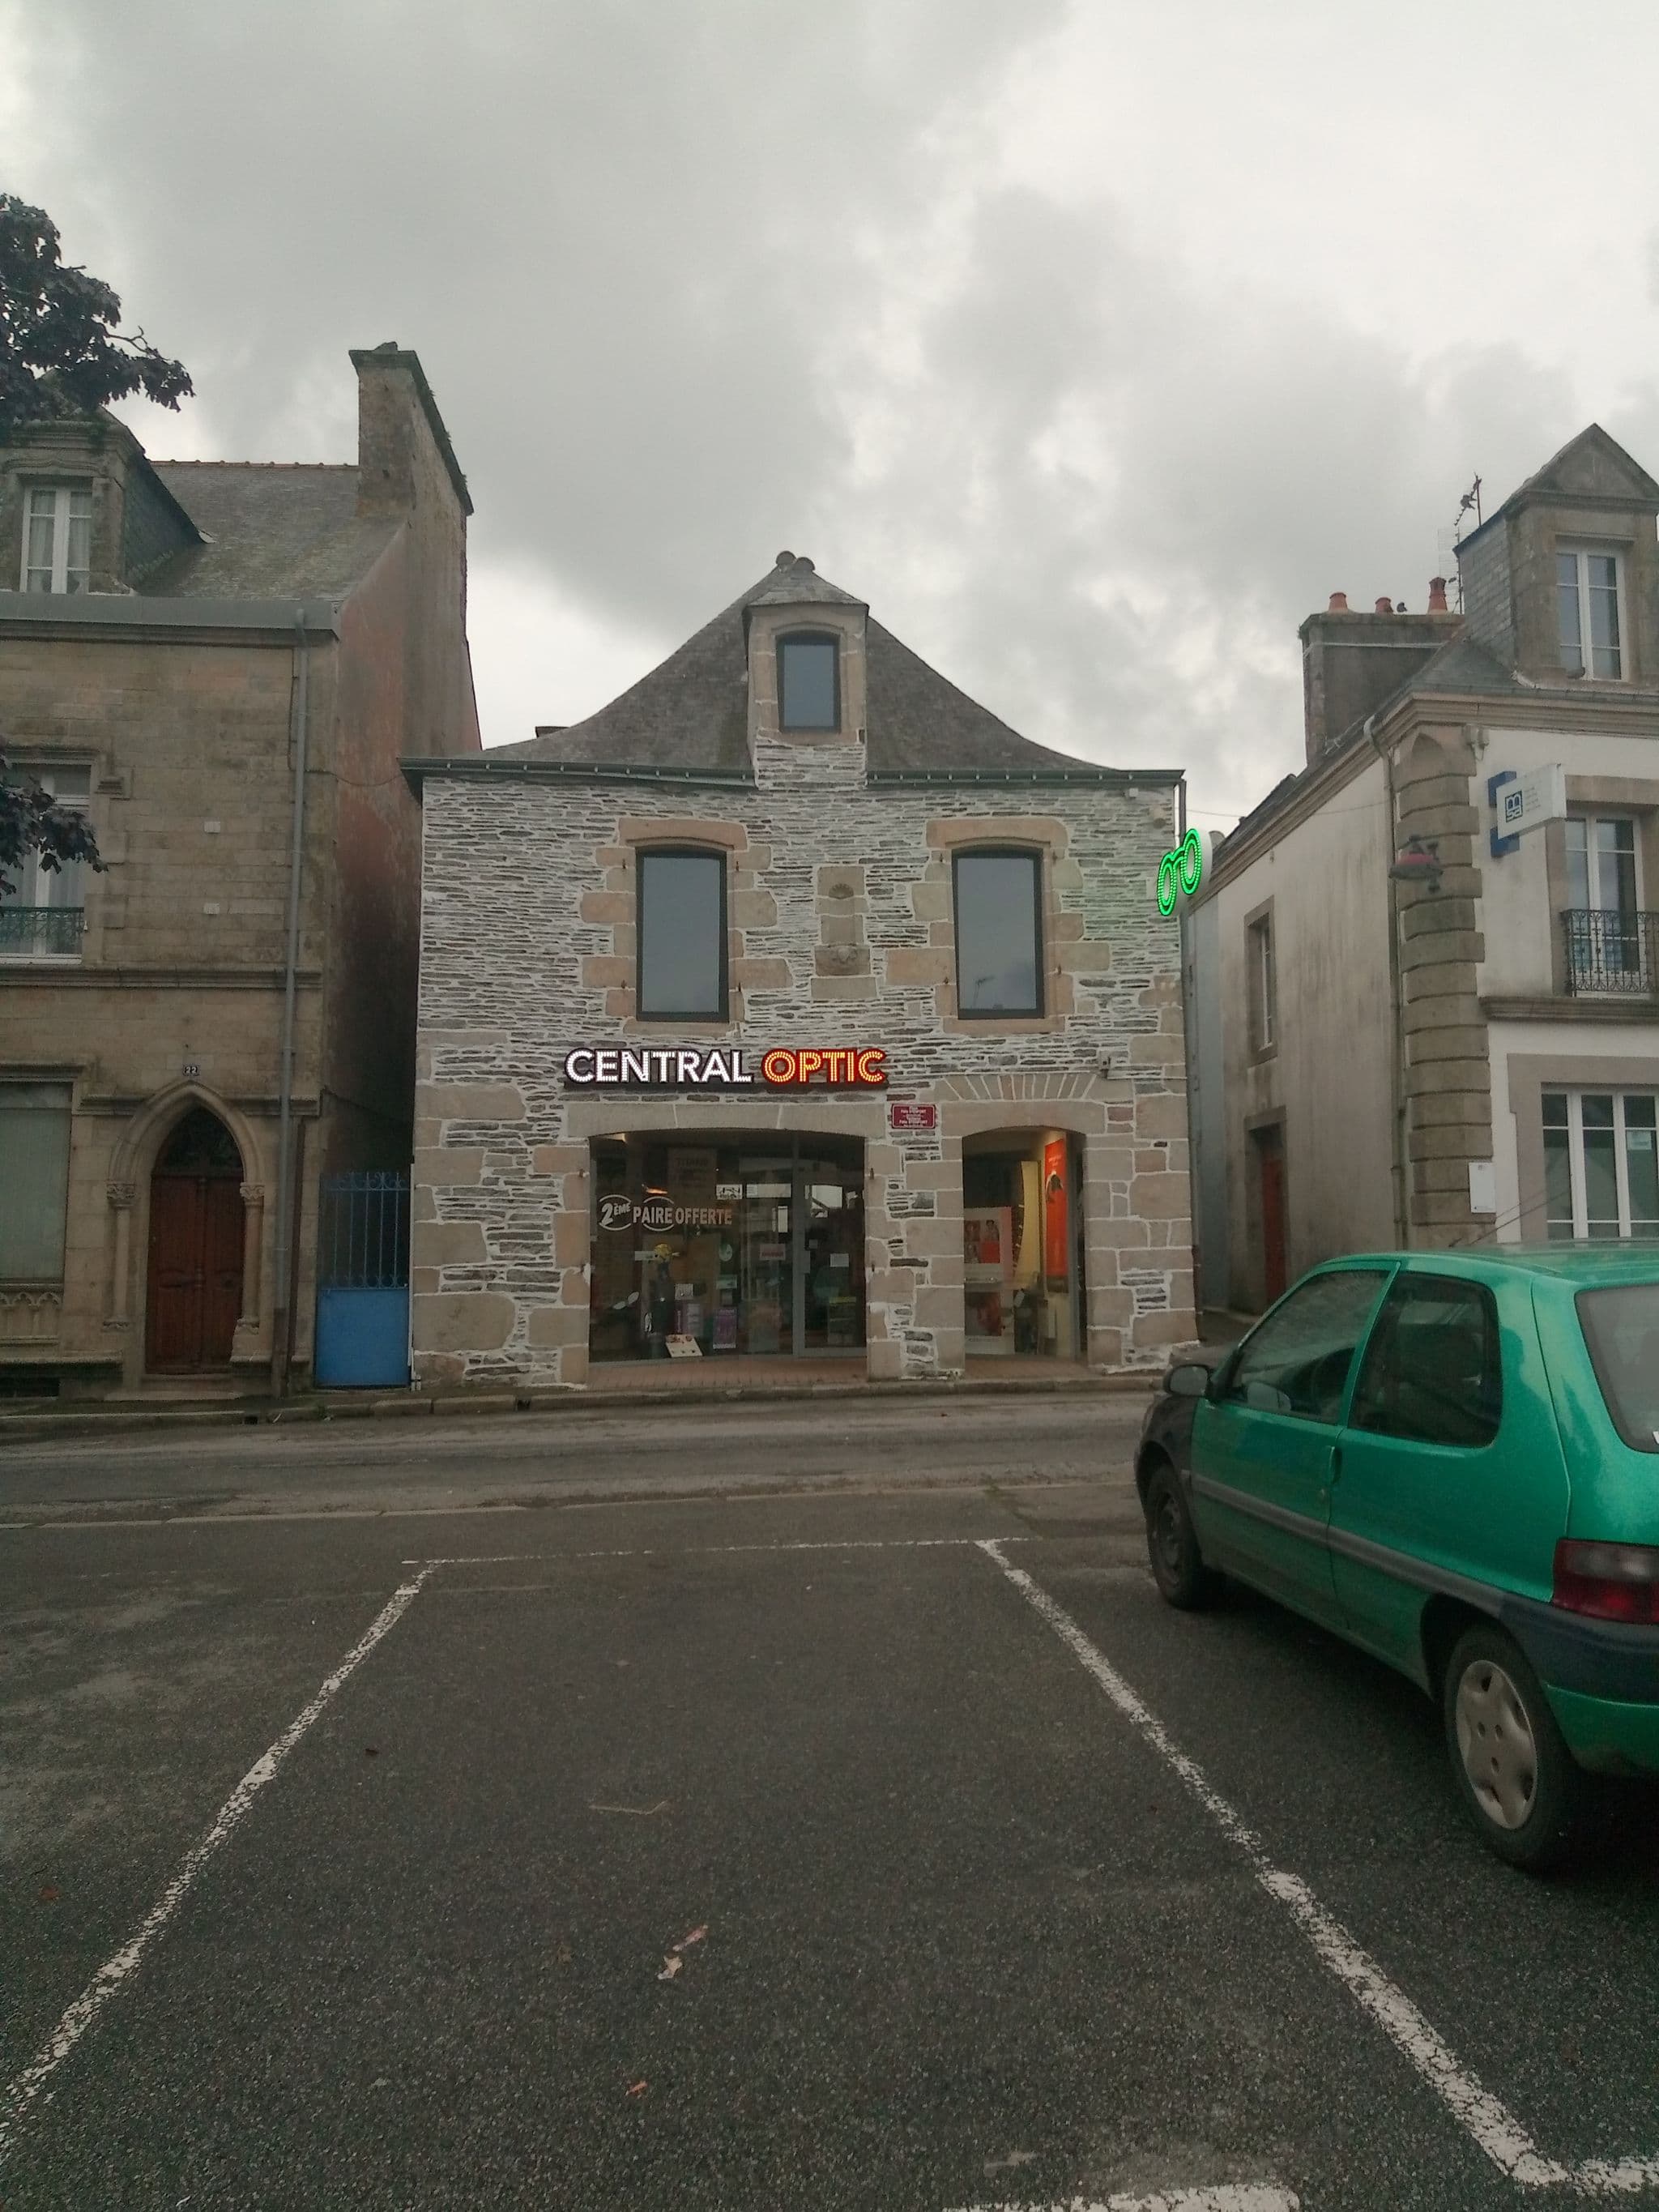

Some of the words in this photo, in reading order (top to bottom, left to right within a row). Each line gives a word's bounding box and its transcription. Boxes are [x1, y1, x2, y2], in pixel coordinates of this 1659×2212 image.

[185, 1065, 198, 1075] 22
[565, 1048, 754, 1083] CENTRAL
[761, 1048, 887, 1084] OPTIC
[633, 1206, 673, 1223] PAIRE
[675, 1208, 732, 1225] OFFERTE
